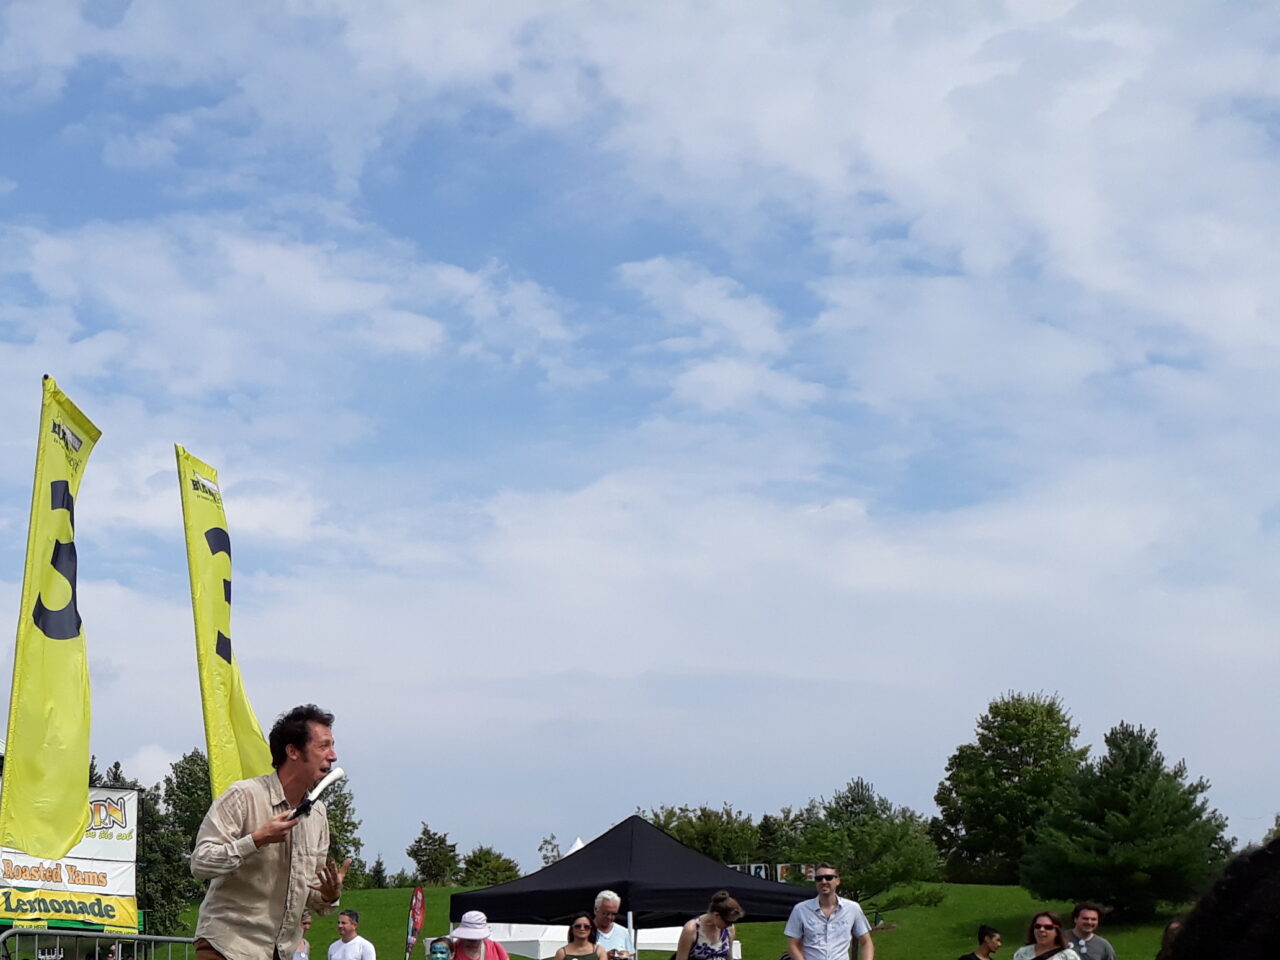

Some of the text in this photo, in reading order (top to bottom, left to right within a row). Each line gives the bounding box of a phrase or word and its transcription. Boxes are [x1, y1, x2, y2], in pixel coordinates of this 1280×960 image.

[2, 858, 108, 887] Roasted Yams
[1, 891, 116, 919] Lemonade
